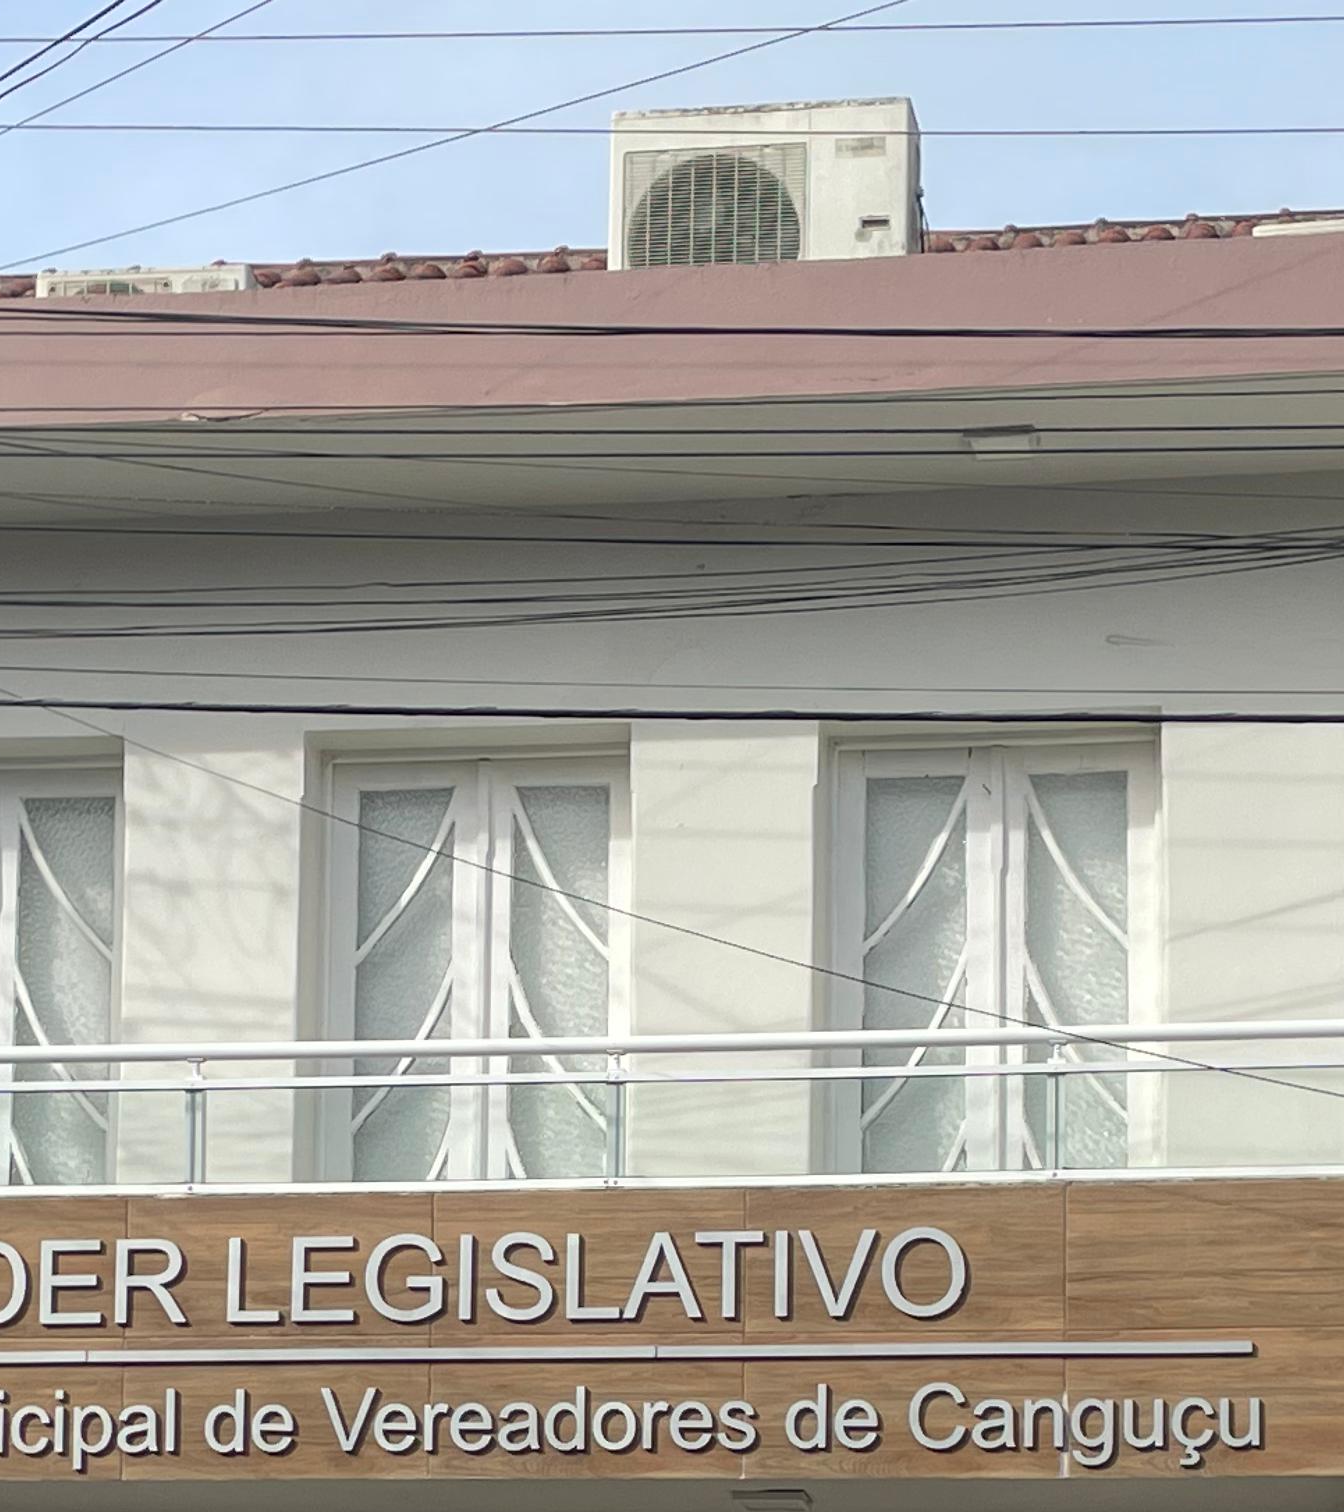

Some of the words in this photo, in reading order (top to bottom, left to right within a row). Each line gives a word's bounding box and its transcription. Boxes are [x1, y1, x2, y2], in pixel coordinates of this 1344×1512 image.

[225, 1226, 969, 1323] LEGISLATIVO
[203, 1388, 296, 1454] de
[321, 1385, 758, 1454] Vereadores
[784, 1383, 879, 1450] de
[908, 1381, 1262, 1467] Canguçu
